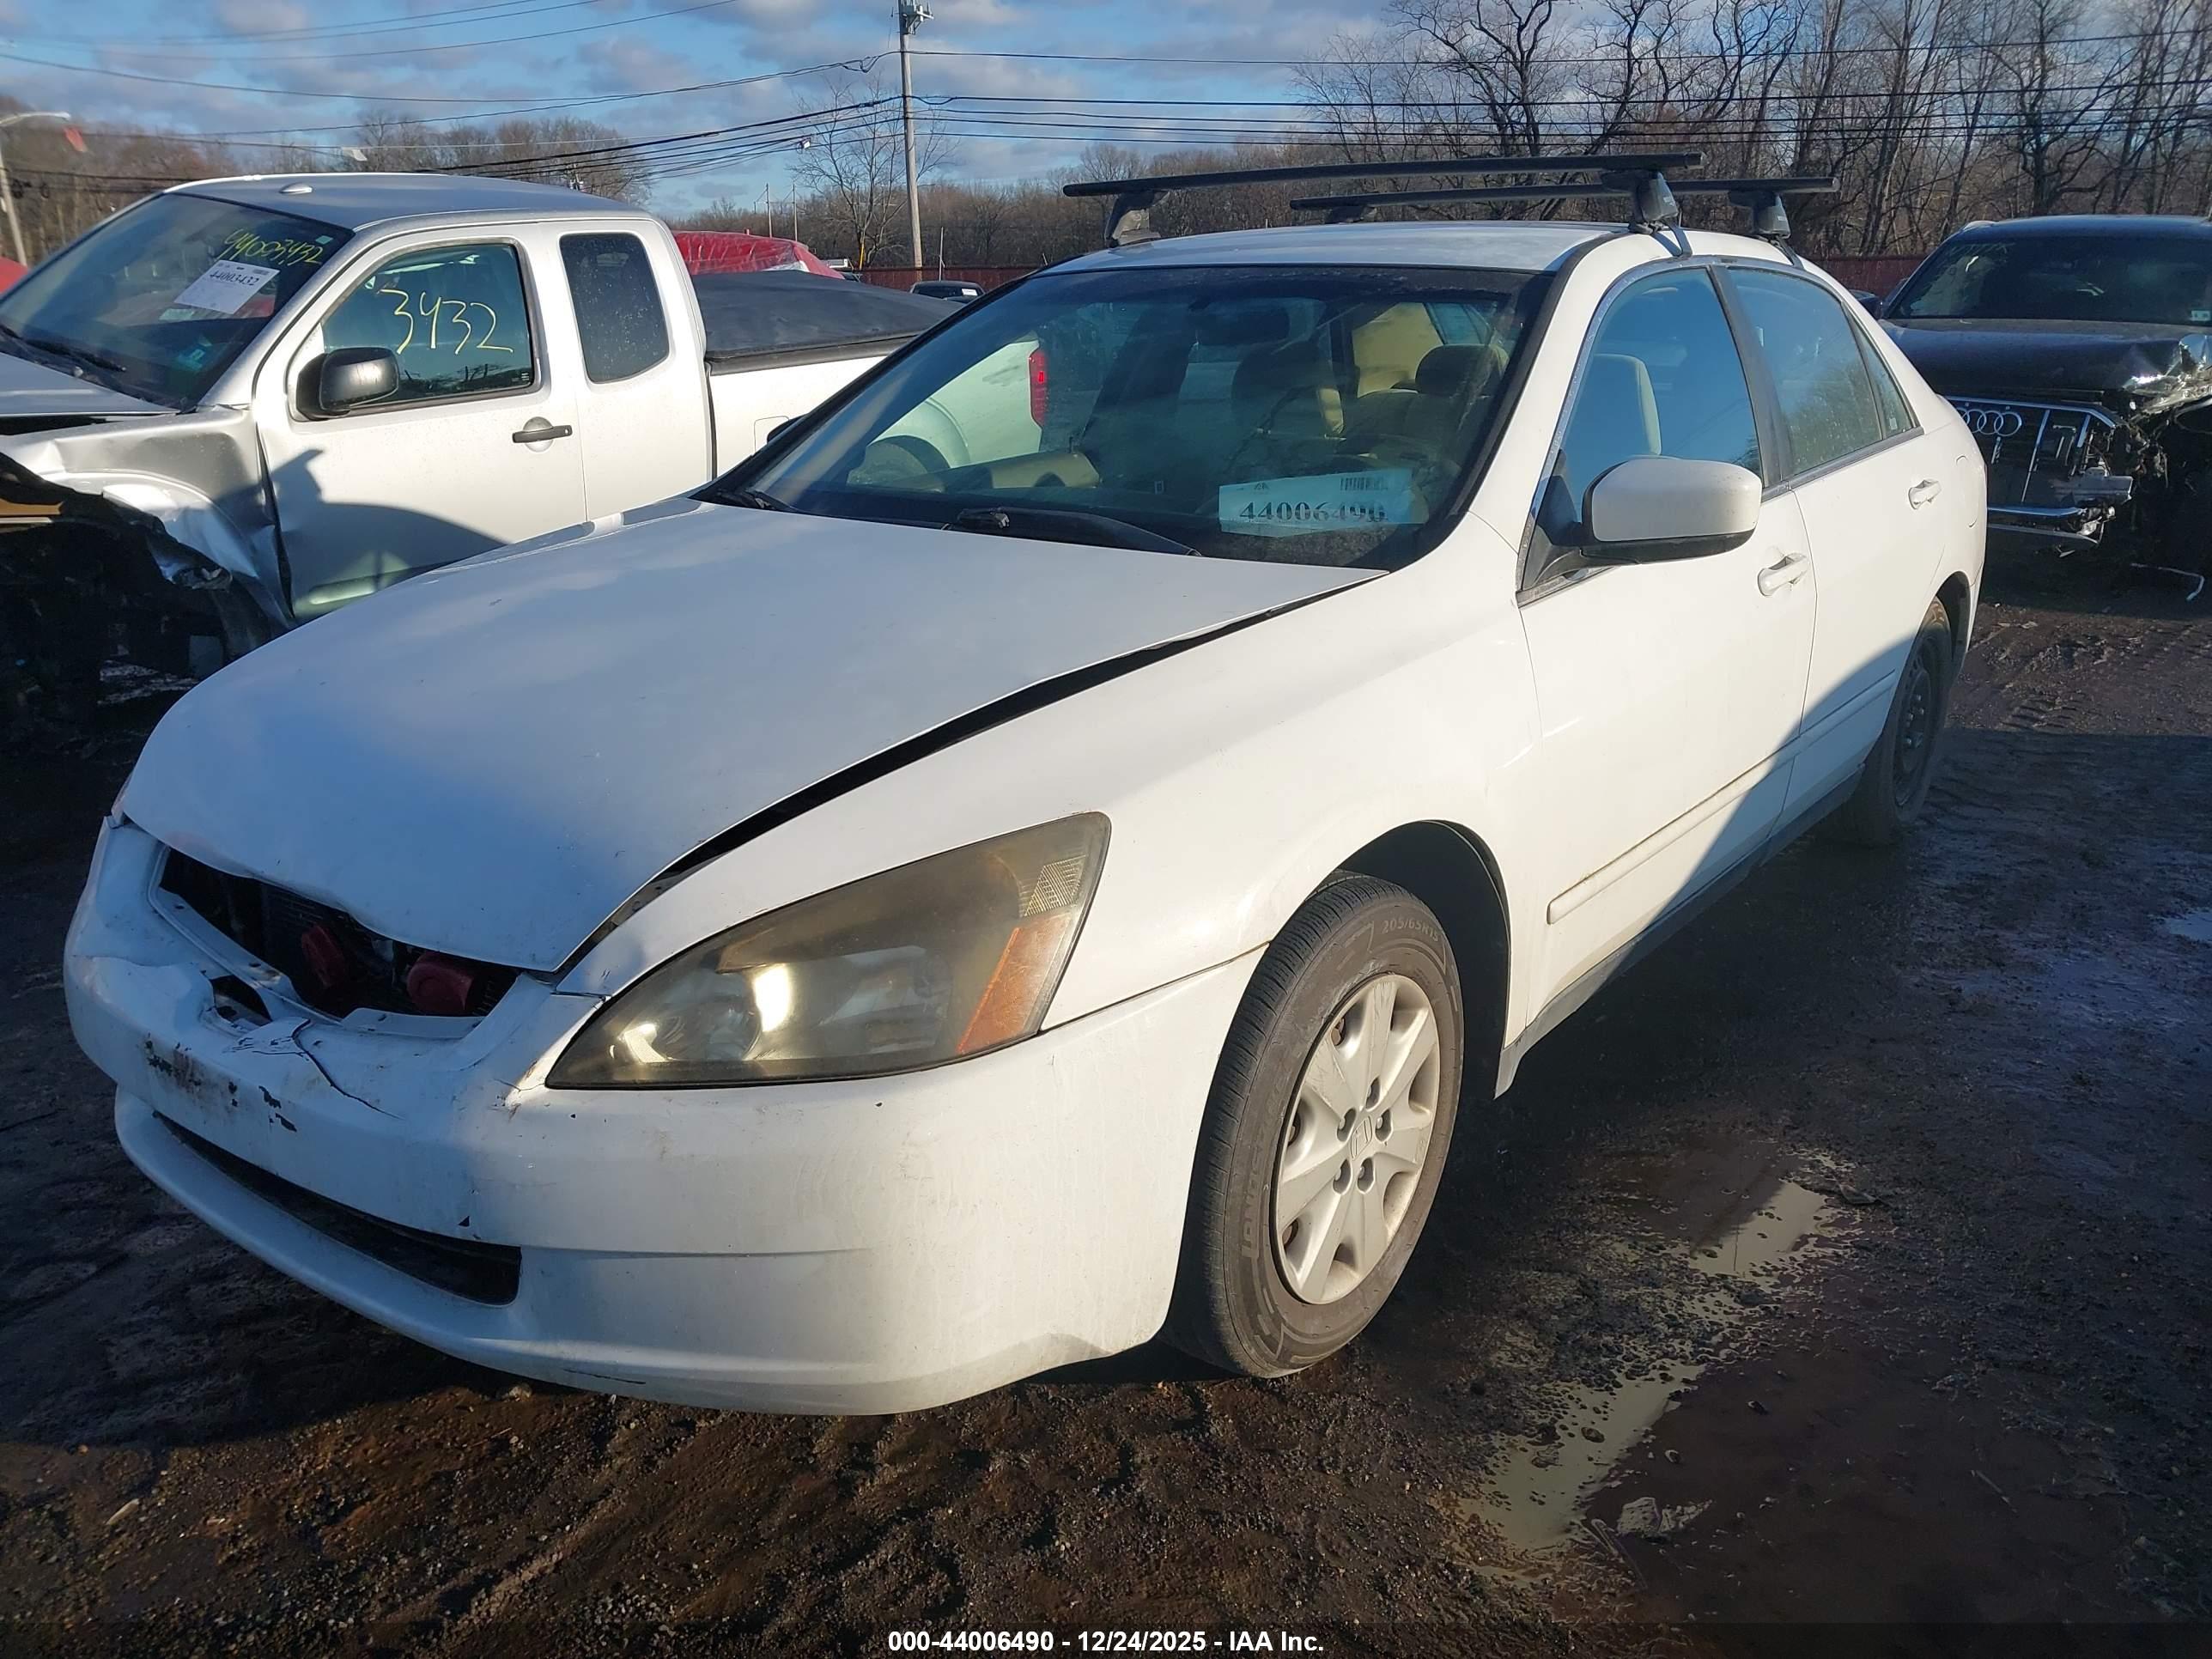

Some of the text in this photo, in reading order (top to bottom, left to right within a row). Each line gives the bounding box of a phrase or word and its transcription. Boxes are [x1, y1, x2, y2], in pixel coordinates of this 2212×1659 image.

[210, 271, 261, 286] 44003432
[380, 289, 515, 355] 3432
[1239, 501, 1388, 523] 44006490
[1382, 917, 1439, 942] 205/65R15
